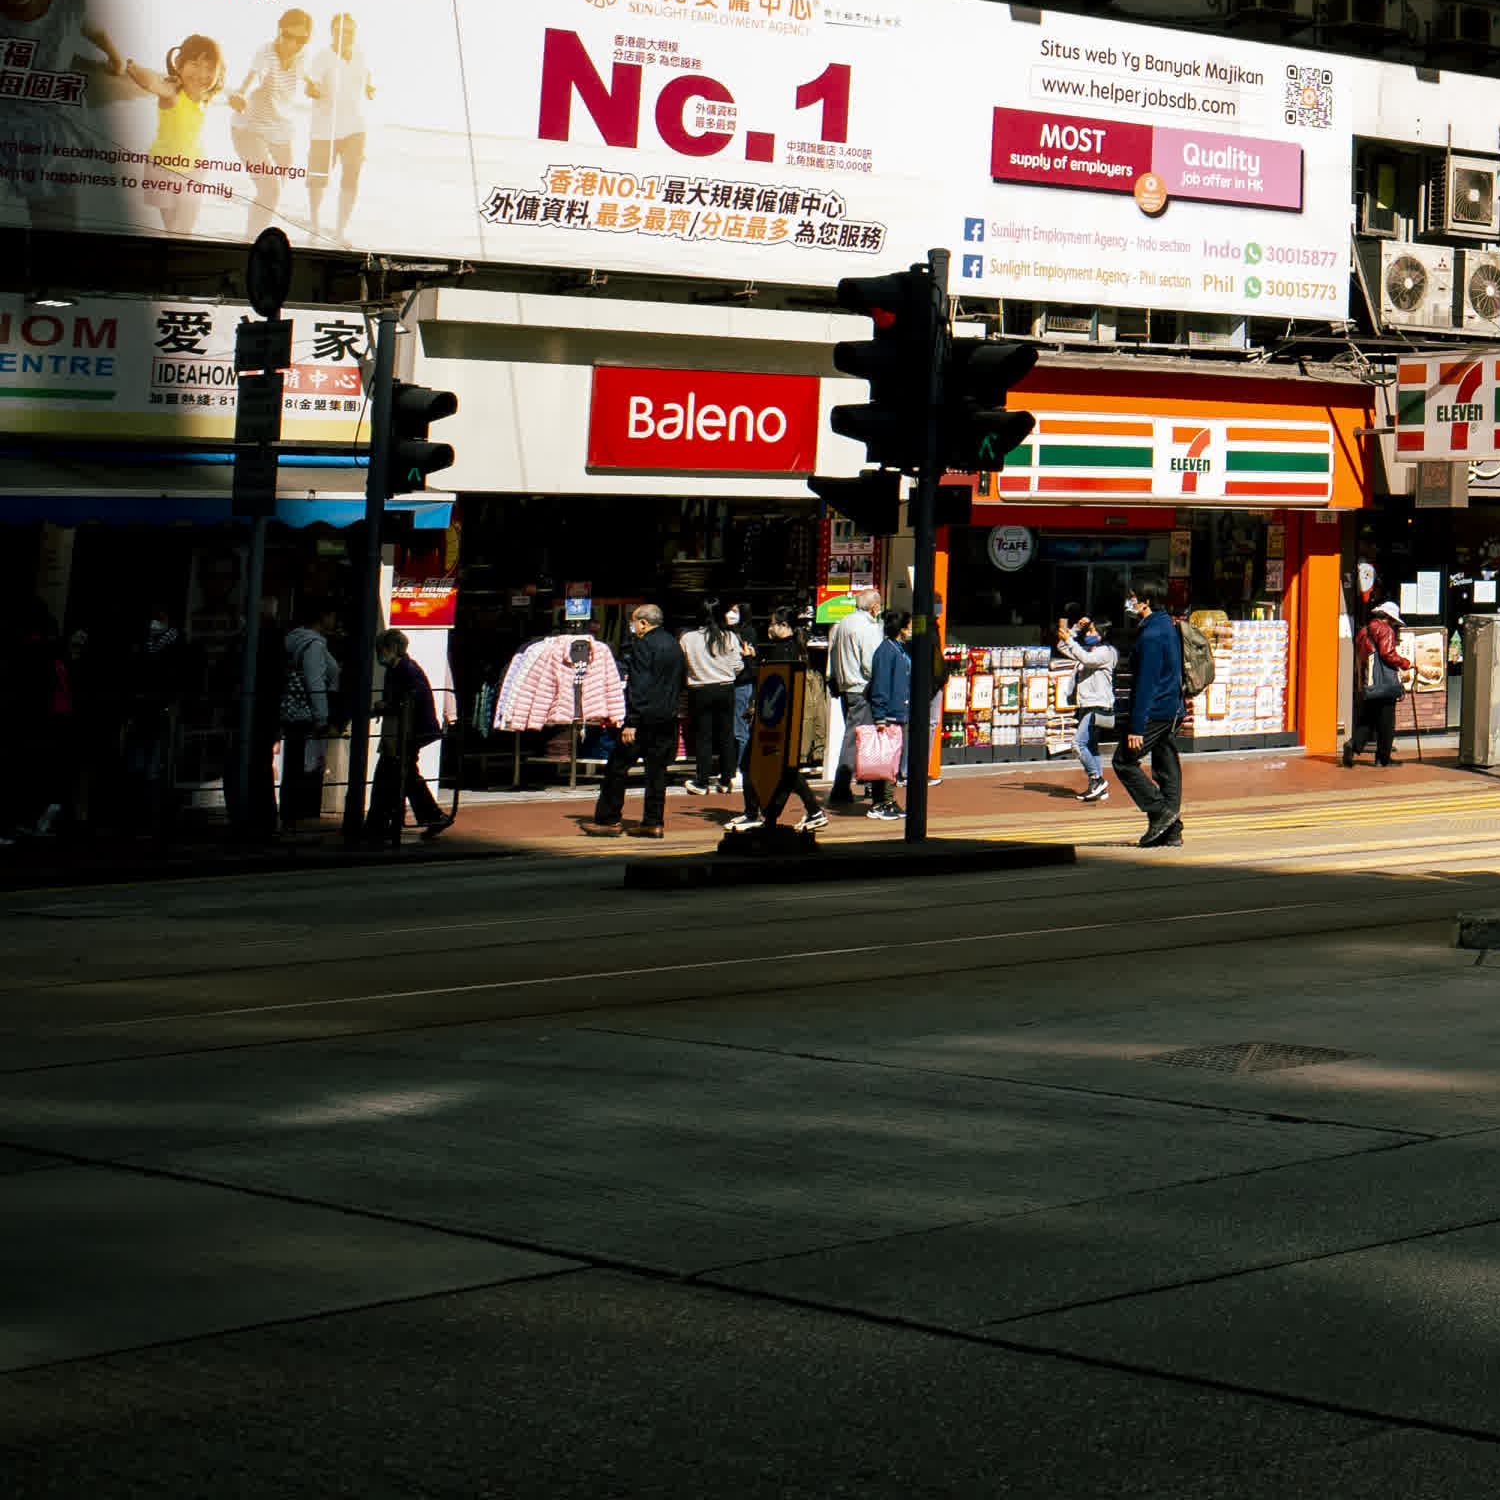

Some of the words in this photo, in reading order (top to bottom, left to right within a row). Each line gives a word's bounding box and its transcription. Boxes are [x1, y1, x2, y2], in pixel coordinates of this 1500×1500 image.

[1040, 39, 1081, 60] Situs
[1085, 47, 1117, 66] web
[1122, 51, 1141, 72] Yg
[1145, 54, 1201, 77] Banyak
[1205, 62, 1264, 85] Majikan
[1042, 77, 1236, 116] www.helperjobsdb.com
[1039, 123, 1106, 153] MOST
[153, 152, 190, 168] pada
[194, 160, 241, 173] semua
[246, 161, 306, 180] keluarga
[1010, 151, 1050, 171] supply
[1054, 154, 1068, 169] of
[1071, 158, 1133, 178] employers
[1183, 142, 1260, 177] Quality
[121, 175, 137, 188] to
[142, 180, 182, 195] every
[187, 179, 233, 198] family
[550, 169, 657, 201] 香港NO.1
[662, 179, 843, 219] 最大規模僱傭中心
[1182, 169, 1200, 187] job
[1203, 173, 1231, 189] offer
[1234, 176, 1245, 190] in
[1247, 177, 1264, 192] HK
[488, 192, 589, 225] 外傭資料
[795, 220, 883, 250] 為您服務
[991, 222, 1030, 243] Sunlight
[1033, 225, 1092, 246] Employment
[1095, 229, 1128, 250] Agency
[1159, 237, 1191, 253] section
[1202, 241, 1241, 260] Indo
[1266, 245, 1338, 269] 30015877
[991, 258, 1030, 278] Sunlight
[1033, 261, 1093, 282] Employment
[1096, 267, 1129, 285] Agency
[1159, 273, 1191, 289] section
[1202, 274, 1234, 293] Phil
[1266, 279, 1338, 301] 30015773
[154, 311, 367, 362] 愛家
[627, 392, 788, 443] Baleno
[1440, 361, 1483, 450] 7
[1172, 427, 1211, 492] 7
